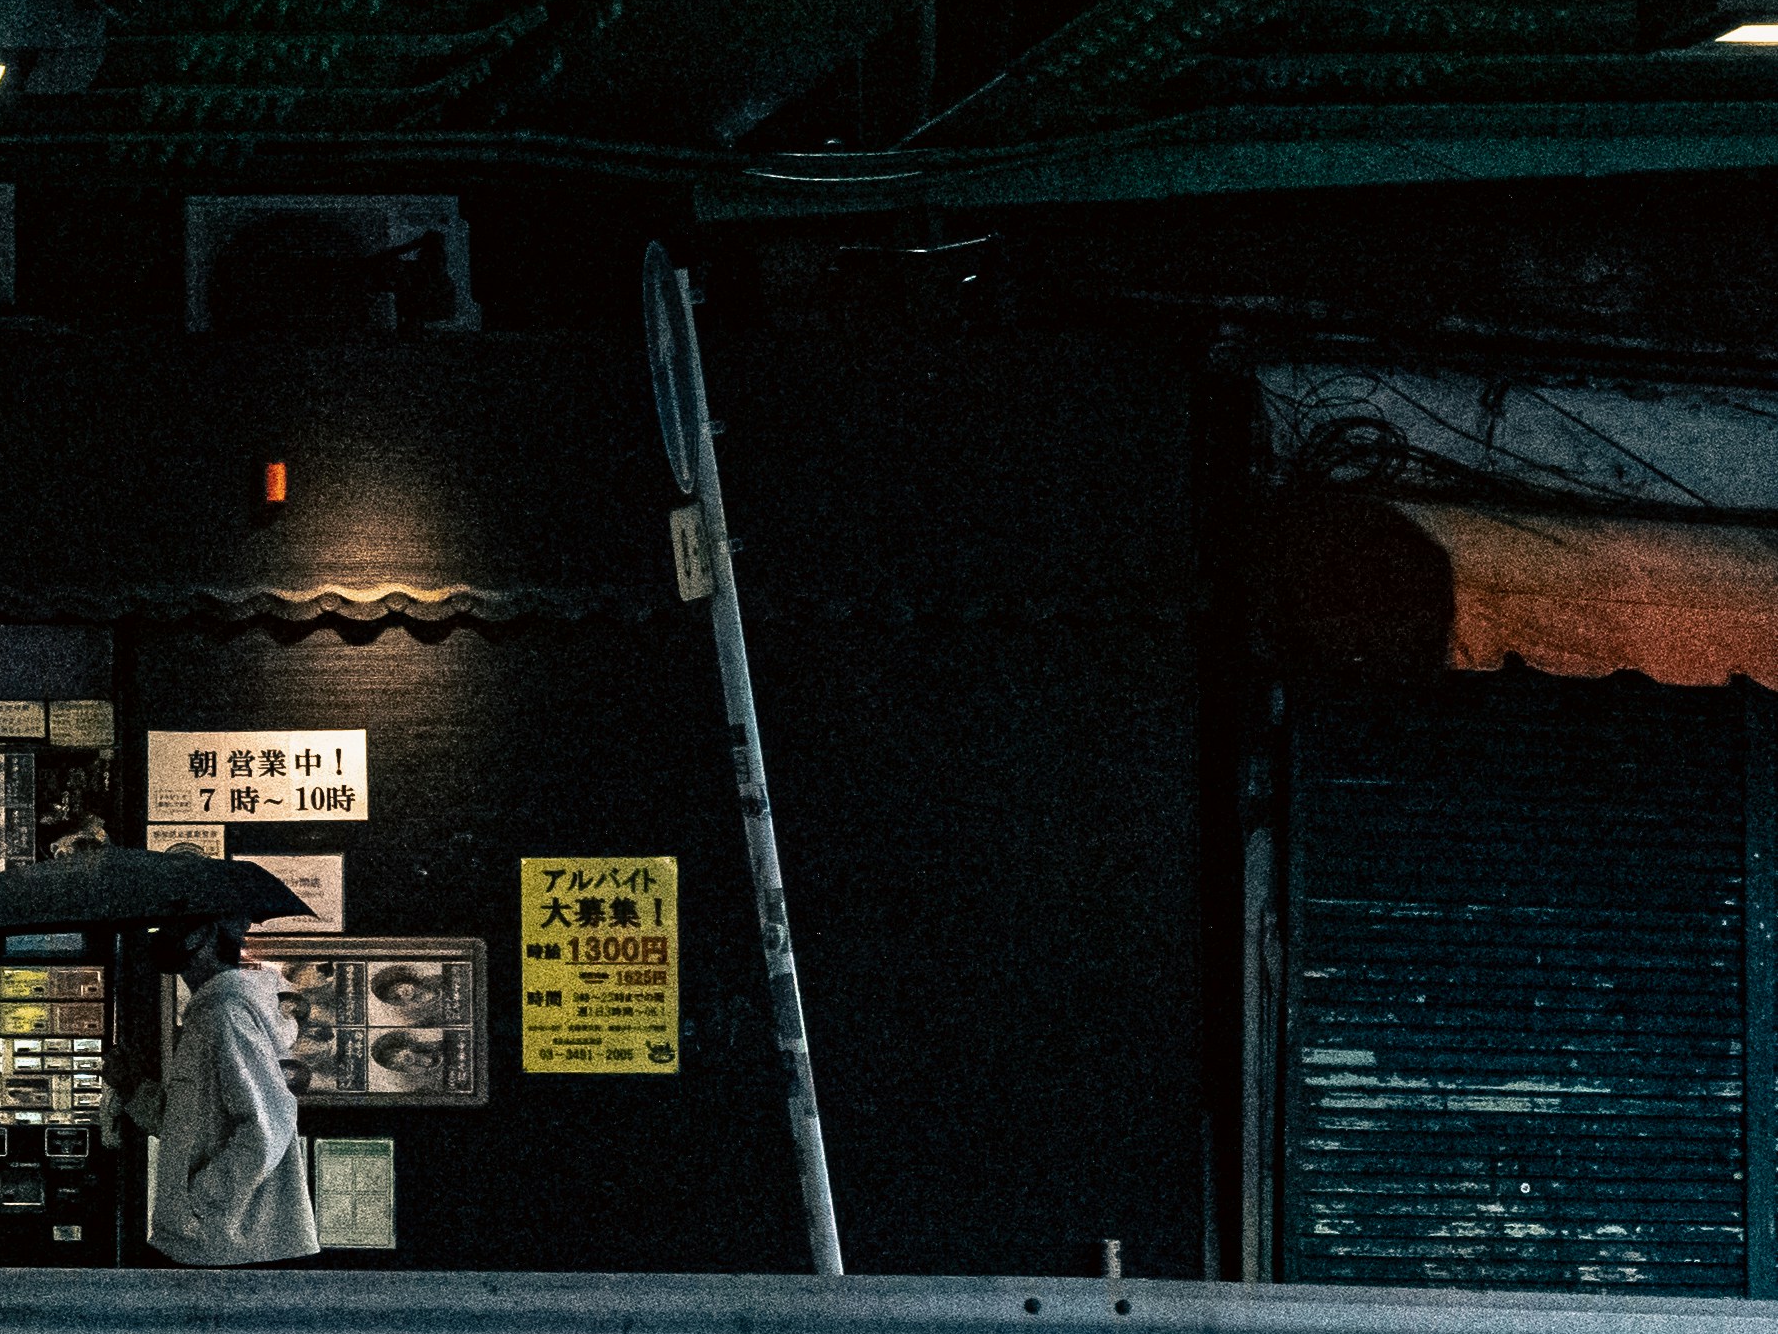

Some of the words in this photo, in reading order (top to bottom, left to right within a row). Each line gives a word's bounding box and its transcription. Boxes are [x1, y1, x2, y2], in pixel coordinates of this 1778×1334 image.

[542, 867, 657, 893] アルバイト
[540, 896, 664, 929] 大募集！
[568, 935, 669, 963] 1300円
[526, 991, 563, 1007] 時間
